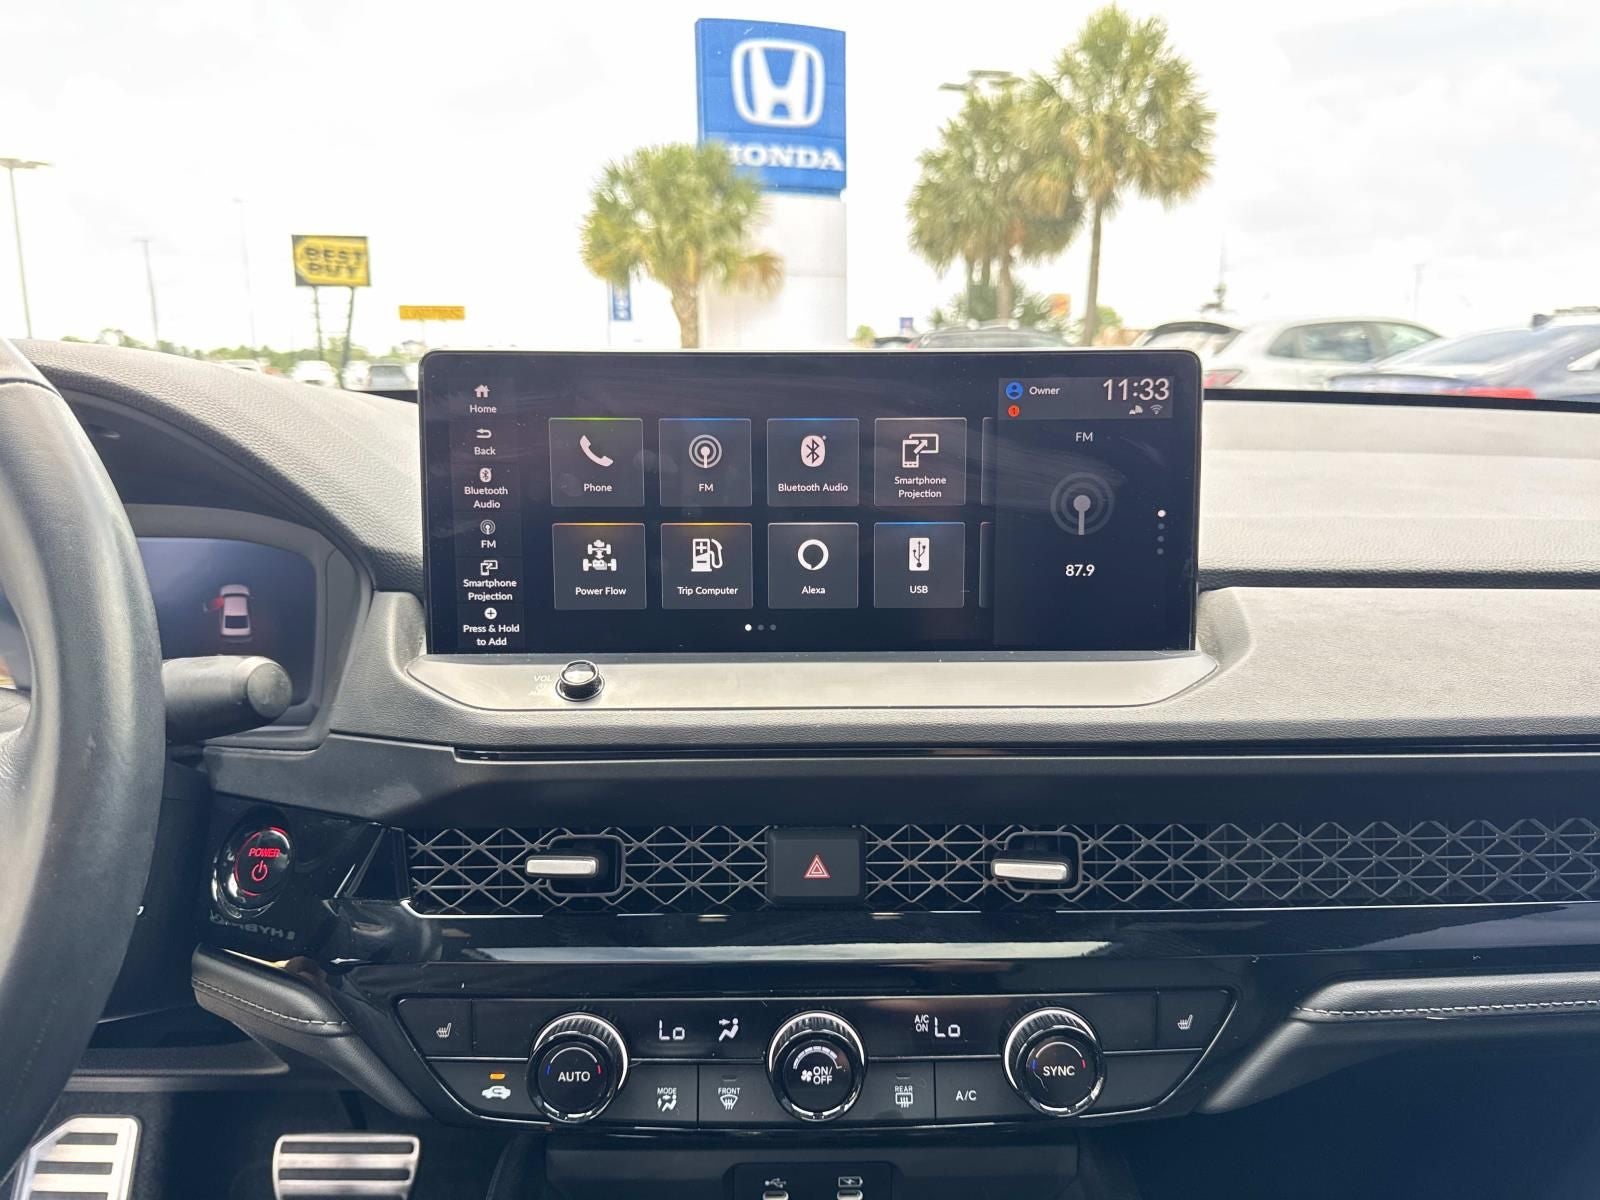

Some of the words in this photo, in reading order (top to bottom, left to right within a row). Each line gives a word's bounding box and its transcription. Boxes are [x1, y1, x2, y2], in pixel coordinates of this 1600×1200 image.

[304, 247, 367, 264] BEST
[1029, 386, 1060, 395] Owner
[1103, 378, 1170, 401] 11:33
[469, 404, 497, 413] Home
[1075, 432, 1094, 442] FM
[474, 446, 496, 455] Back
[894, 476, 947, 486] Smartphone
[464, 486, 508, 495] Bluetooth
[583, 483, 612, 492] Phone
[698, 483, 714, 492] FM
[778, 483, 820, 492] Bluetooth
[822, 483, 848, 492] Audio
[898, 489, 942, 499] Projection
[473, 500, 501, 509] Audio
[481, 540, 496, 549] FM
[1065, 564, 1095, 577] 87.9
[463, 579, 517, 589] Smartphone
[575, 587, 603, 596] Power
[605, 587, 627, 596] Flow
[677, 586, 693, 597] Trip
[695, 586, 738, 597] Computer
[801, 586, 826, 594] Alexa
[909, 586, 928, 594] USB
[468, 592, 512, 602] Projection
[463, 624, 486, 633] Press
[488, 624, 496, 633] &
[498, 624, 520, 633] Hold
[476, 638, 486, 646] to
[488, 637, 507, 646] Add
[249, 848, 280, 857] POWER
[914, 1015, 929, 1024] A/C
[658, 1019, 685, 1040] Lo
[915, 1023, 928, 1032] ON
[934, 1016, 960, 1037] Lo
[813, 1066, 833, 1077] ON/
[1043, 1065, 1075, 1076] SYNC
[558, 1071, 591, 1082] AUTO
[813, 1075, 832, 1085] OFF
[657, 1087, 677, 1095] MODE
[718, 1087, 741, 1095] FRONT
[955, 1090, 977, 1101] A/C
